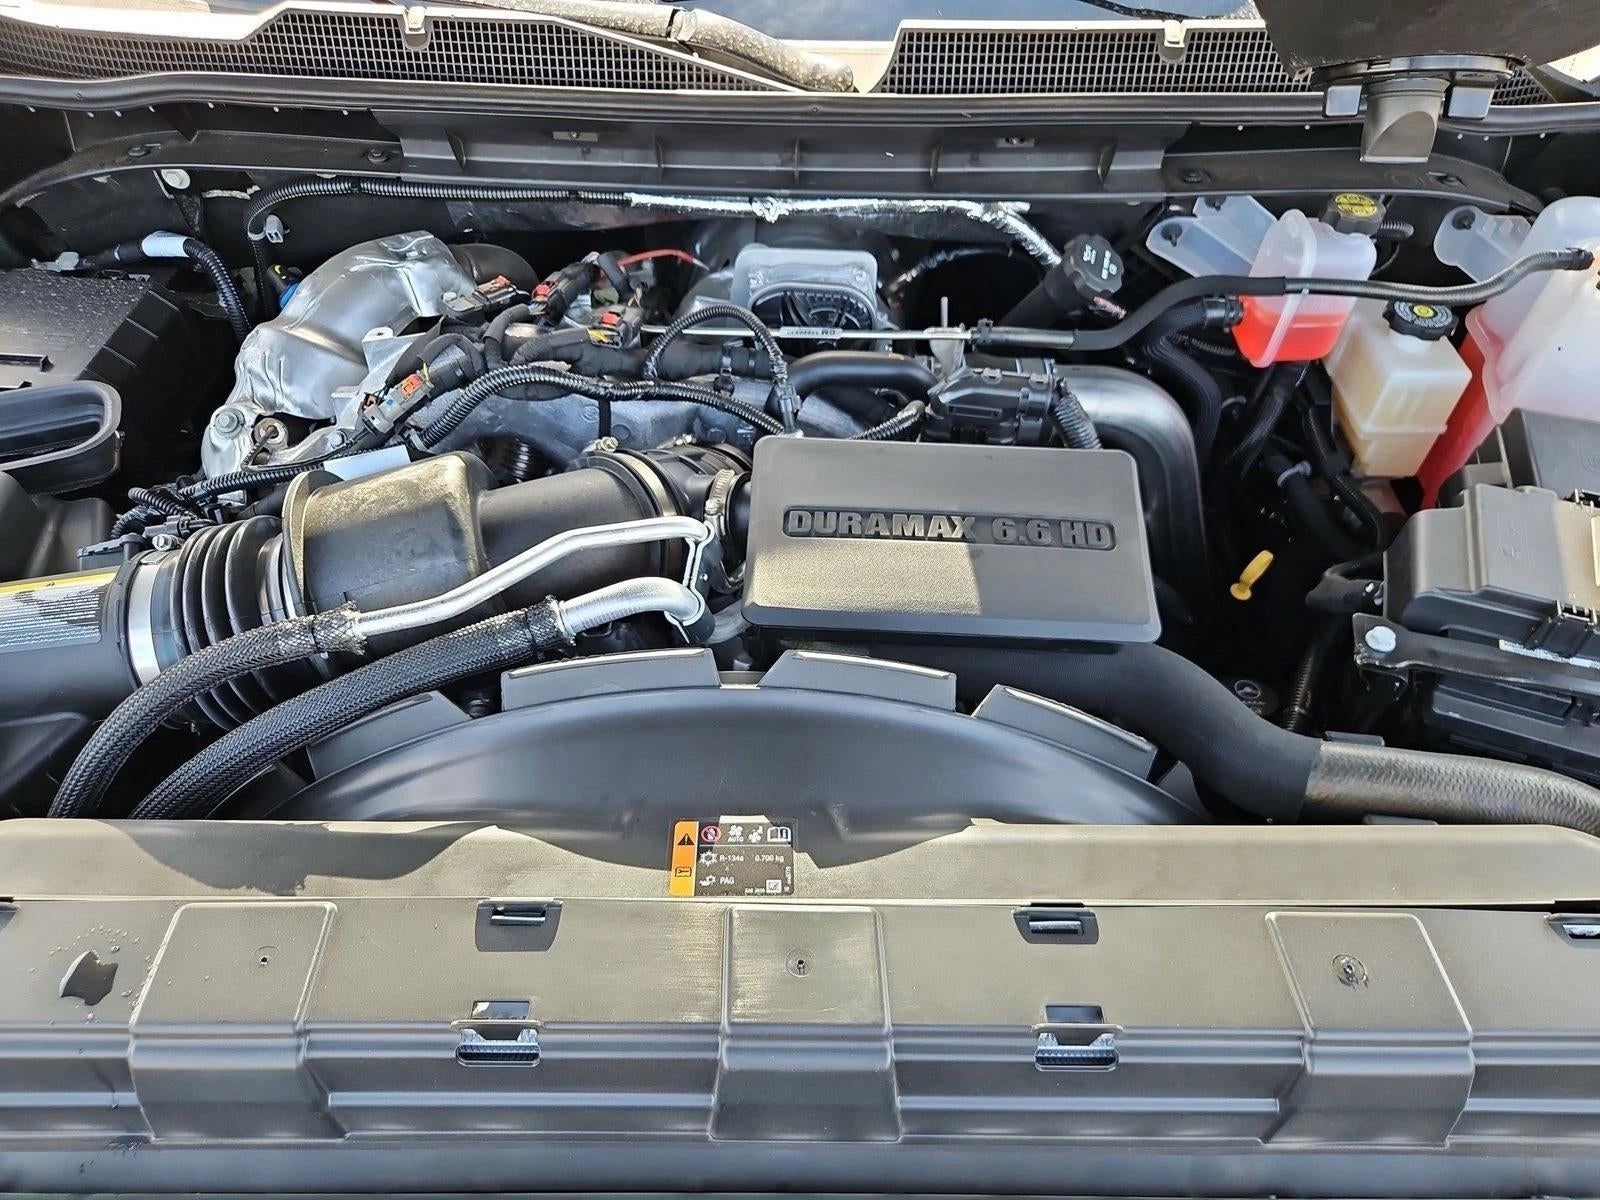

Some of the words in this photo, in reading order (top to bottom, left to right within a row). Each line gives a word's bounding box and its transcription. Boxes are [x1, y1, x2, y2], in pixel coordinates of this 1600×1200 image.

[787, 510, 976, 543] DURAMAX
[991, 517, 1053, 546] 6.6
[1060, 520, 1113, 549] HD
[719, 854, 744, 862] R-134a
[754, 854, 774, 862] 0.700
[775, 854, 785, 863] kg
[719, 876, 735, 885] PAG
